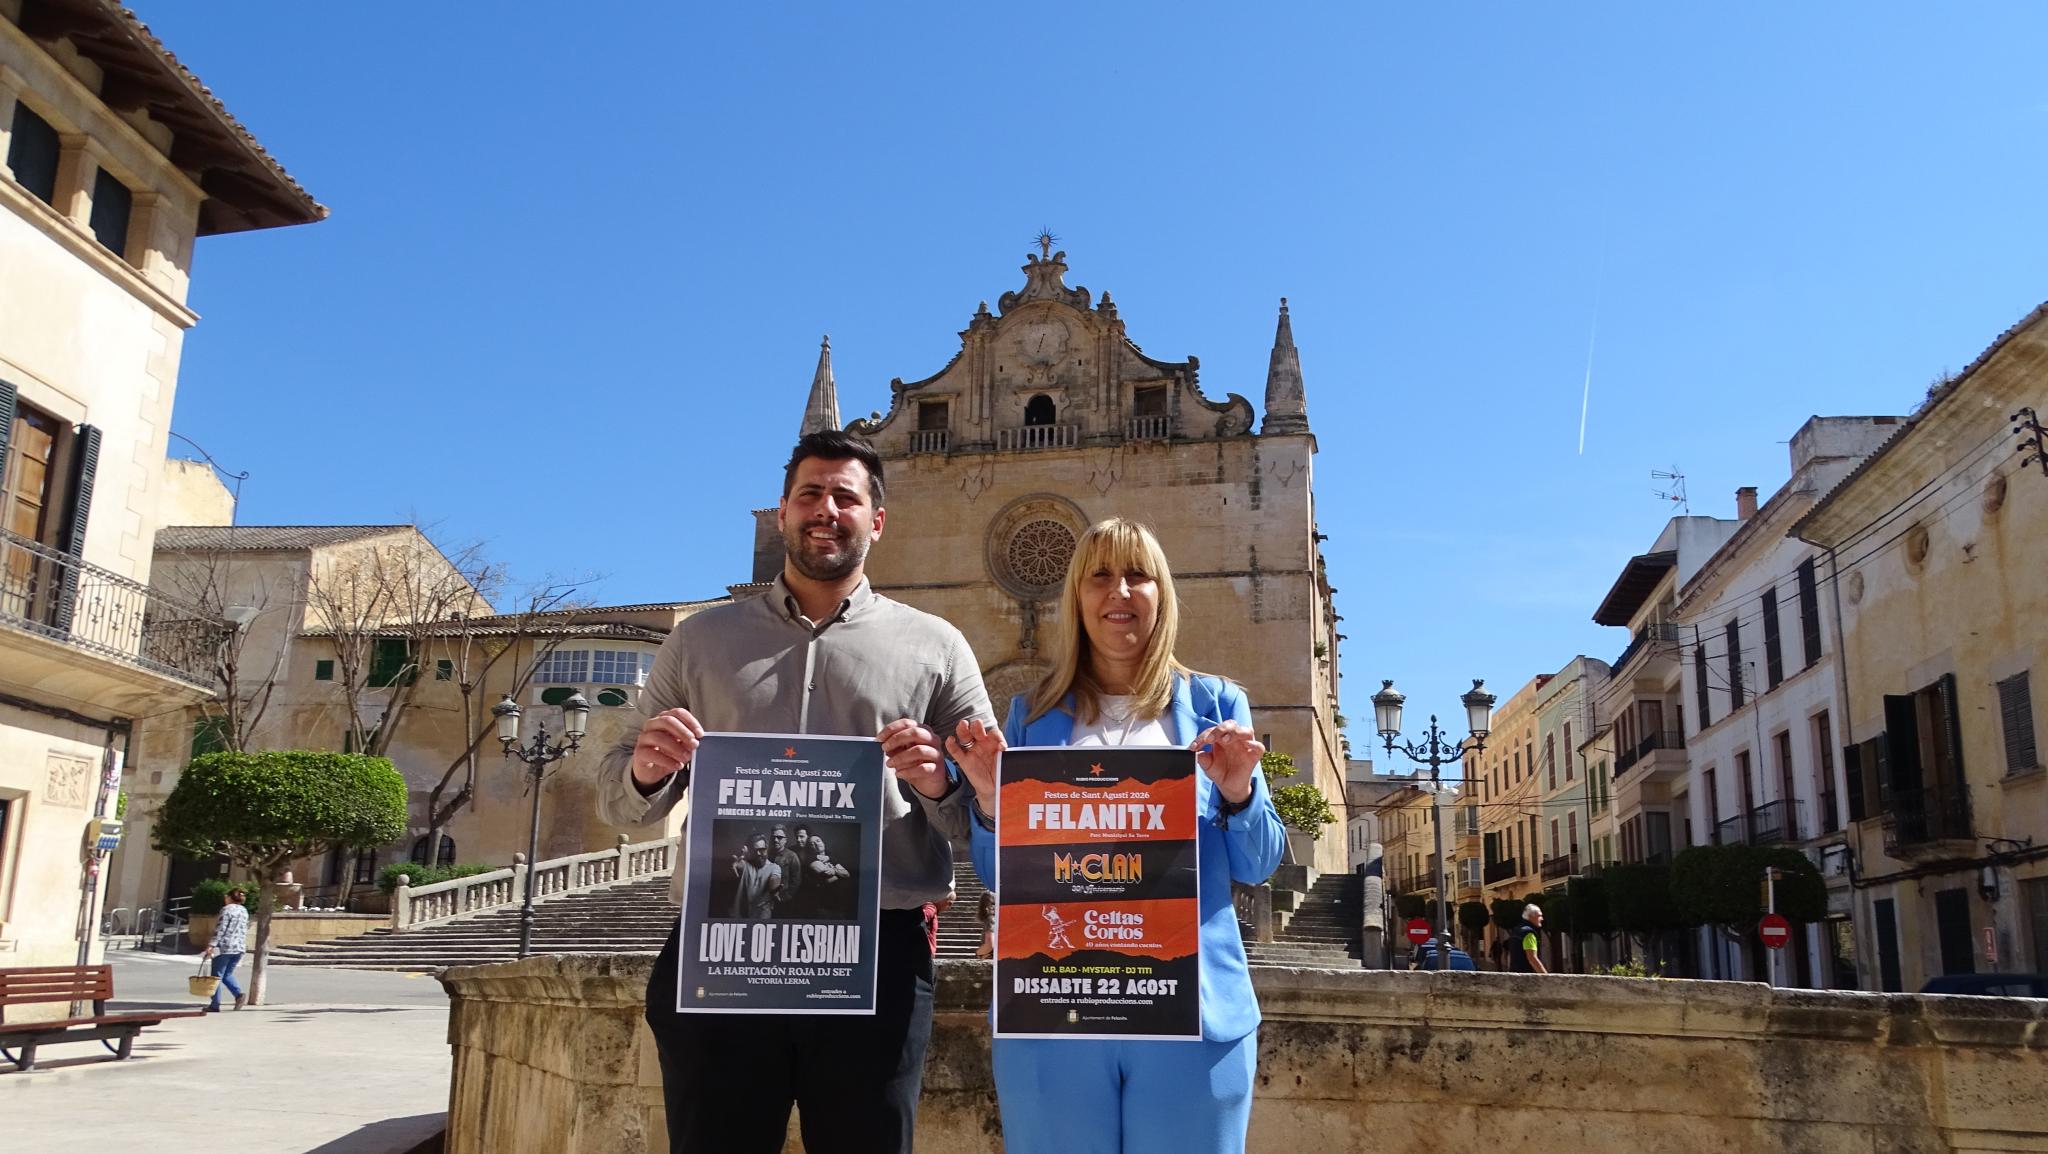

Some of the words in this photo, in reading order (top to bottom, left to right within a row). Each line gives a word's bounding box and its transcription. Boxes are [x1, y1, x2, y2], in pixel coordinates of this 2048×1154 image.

[735, 766, 760, 775] Festes
[761, 767, 772, 775] de
[773, 767, 792, 776] Sant
[794, 768, 820, 778] Agustí
[718, 778, 856, 809] FELANITX
[1044, 791, 1068, 799] Festes
[1070, 791, 1081, 799] de
[1082, 791, 1101, 799] Sant
[1102, 791, 1128, 801] Agustí
[1130, 791, 1150, 799] 2026
[718, 808, 754, 816] DIMECRES
[768, 809, 792, 817] AGOST
[1028, 803, 1165, 830] FELANITX
[1083, 909, 1144, 925] Celtas
[1083, 924, 1144, 939] Cortos
[698, 922, 747, 962] LOVE
[751, 923, 777, 963] OF
[780, 924, 860, 964] LESBIAN
[708, 966, 721, 975] LA
[723, 965, 786, 976] HABITACIÓN
[788, 967, 815, 976] ROJA
[817, 967, 831, 976] DJ
[832, 967, 852, 977] SET
[1059, 966, 1077, 974] BAD
[1082, 966, 1121, 974] MYSTART
[747, 977, 783, 985] VICTORIA
[1013, 977, 1092, 994] DISSABTE
[1097, 978, 1120, 995] 22
[1126, 979, 1178, 996] AGOST
